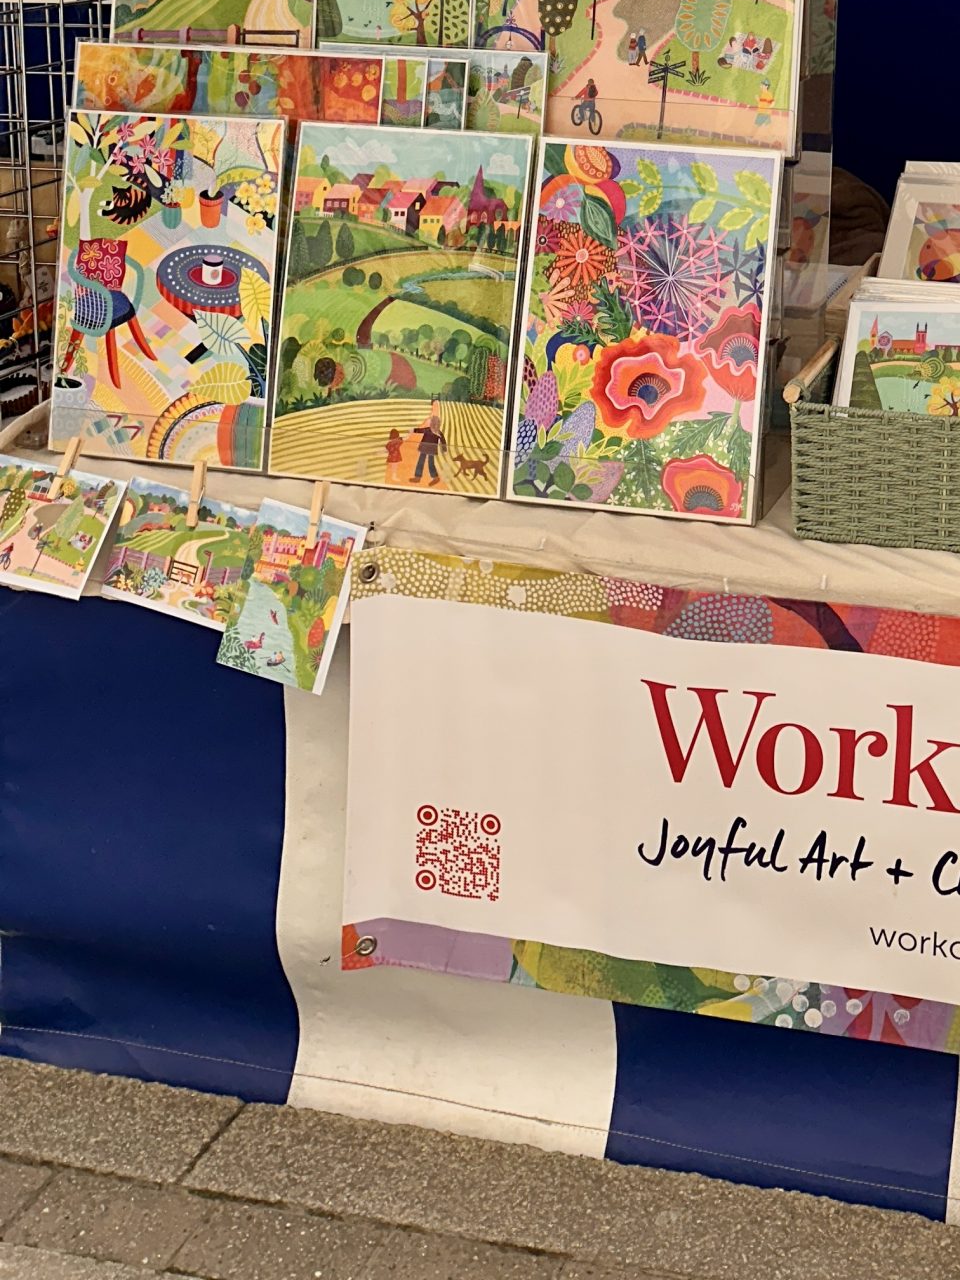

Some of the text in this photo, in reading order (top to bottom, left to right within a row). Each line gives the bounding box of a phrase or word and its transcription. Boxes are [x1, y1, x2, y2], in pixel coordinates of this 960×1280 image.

[637, 816, 787, 882] Joyful
[798, 829, 875, 882] Art
[885, 858, 915, 885] +
